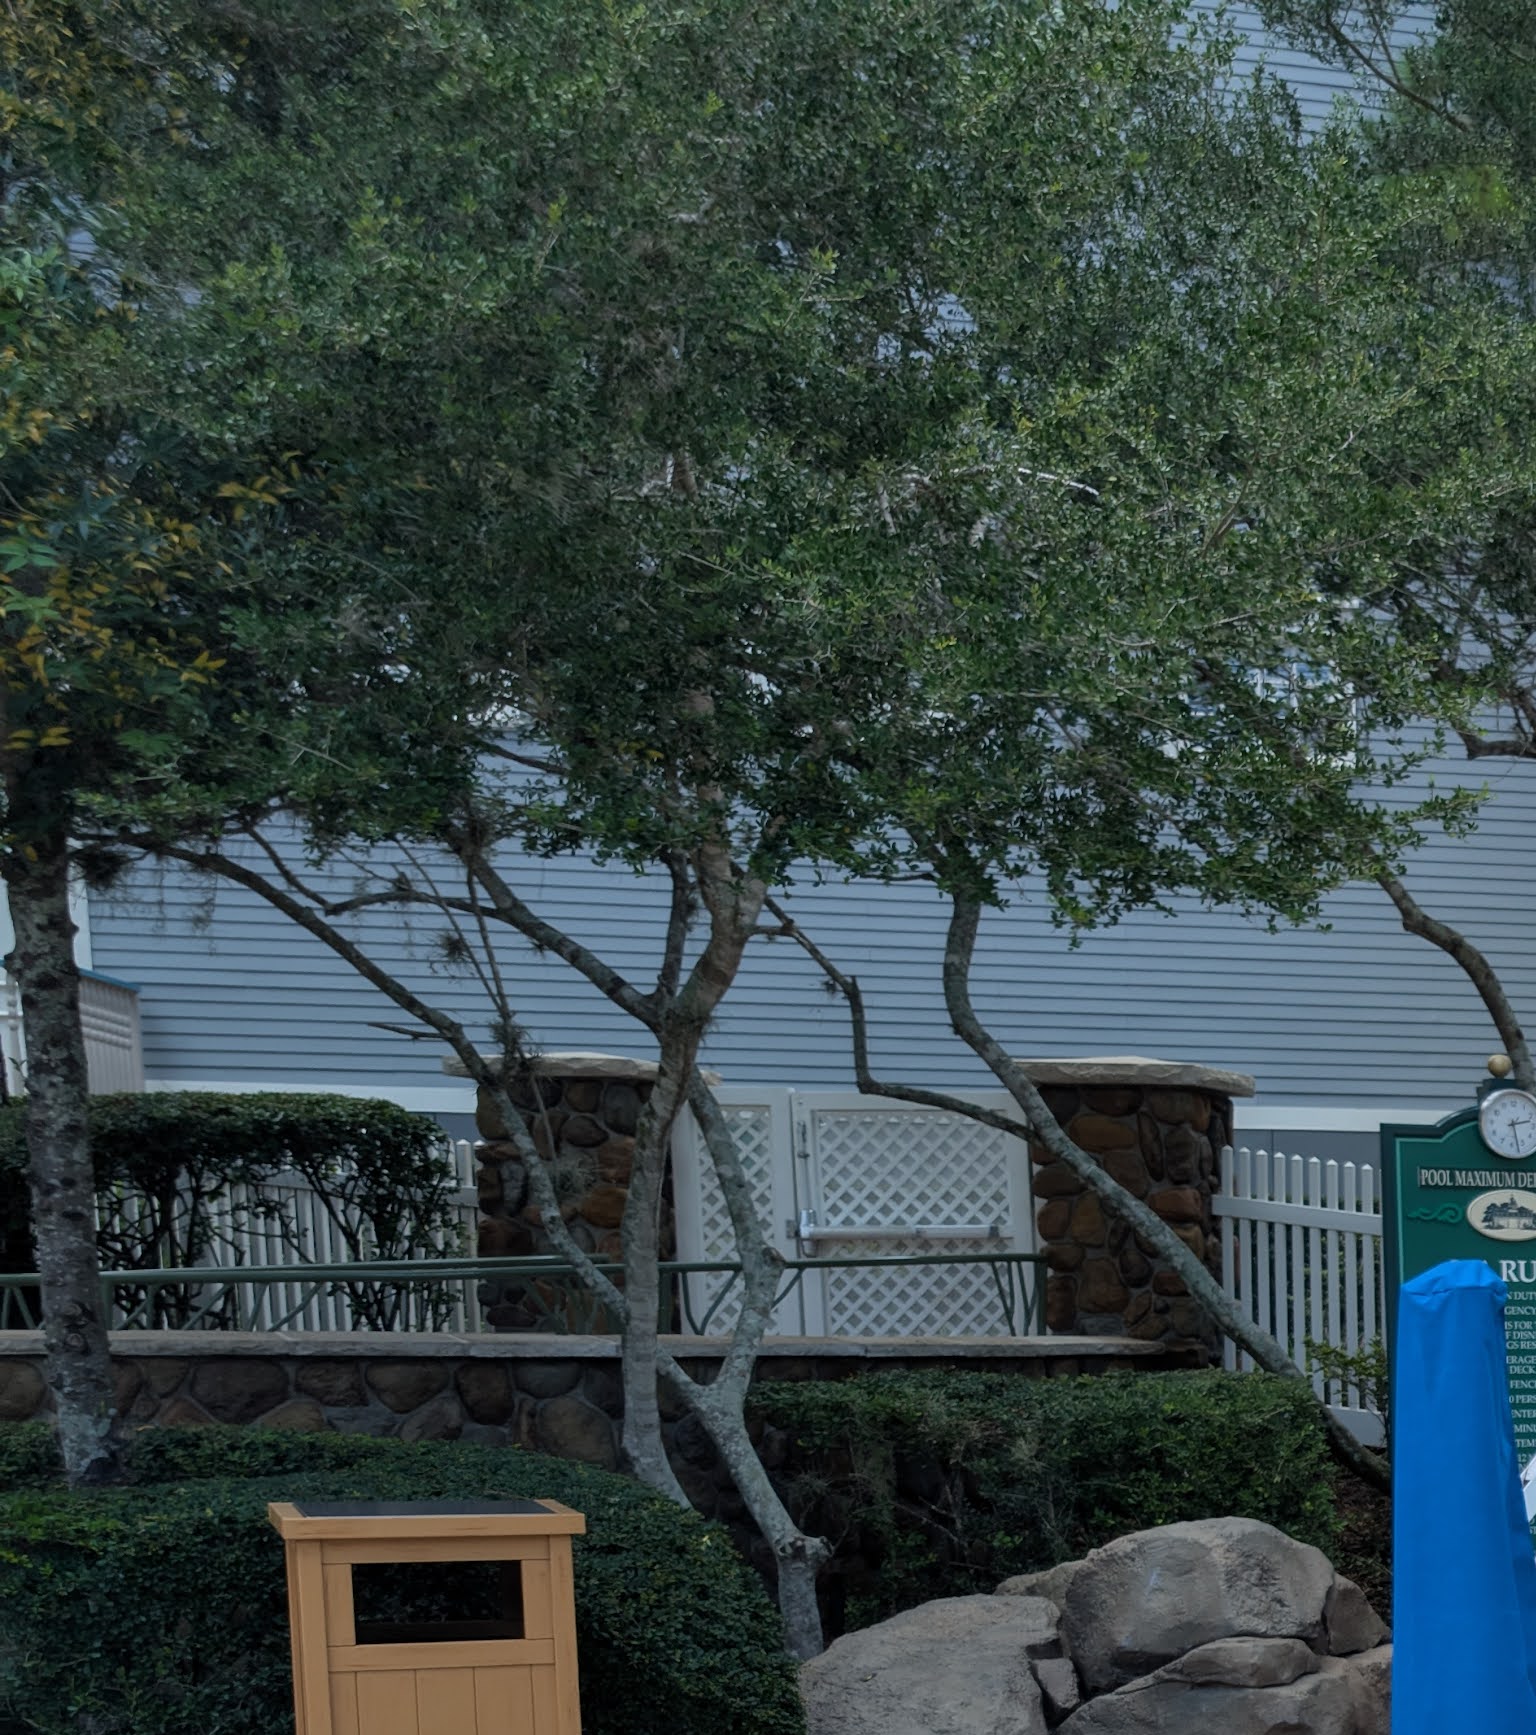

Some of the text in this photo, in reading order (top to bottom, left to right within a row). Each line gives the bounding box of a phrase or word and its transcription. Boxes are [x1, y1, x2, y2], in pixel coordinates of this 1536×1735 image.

[1421, 1168, 1453, 1186] POOL
[1455, 1170, 1515, 1188] MAXIMUM
[1514, 1321, 1532, 1330] FOR
